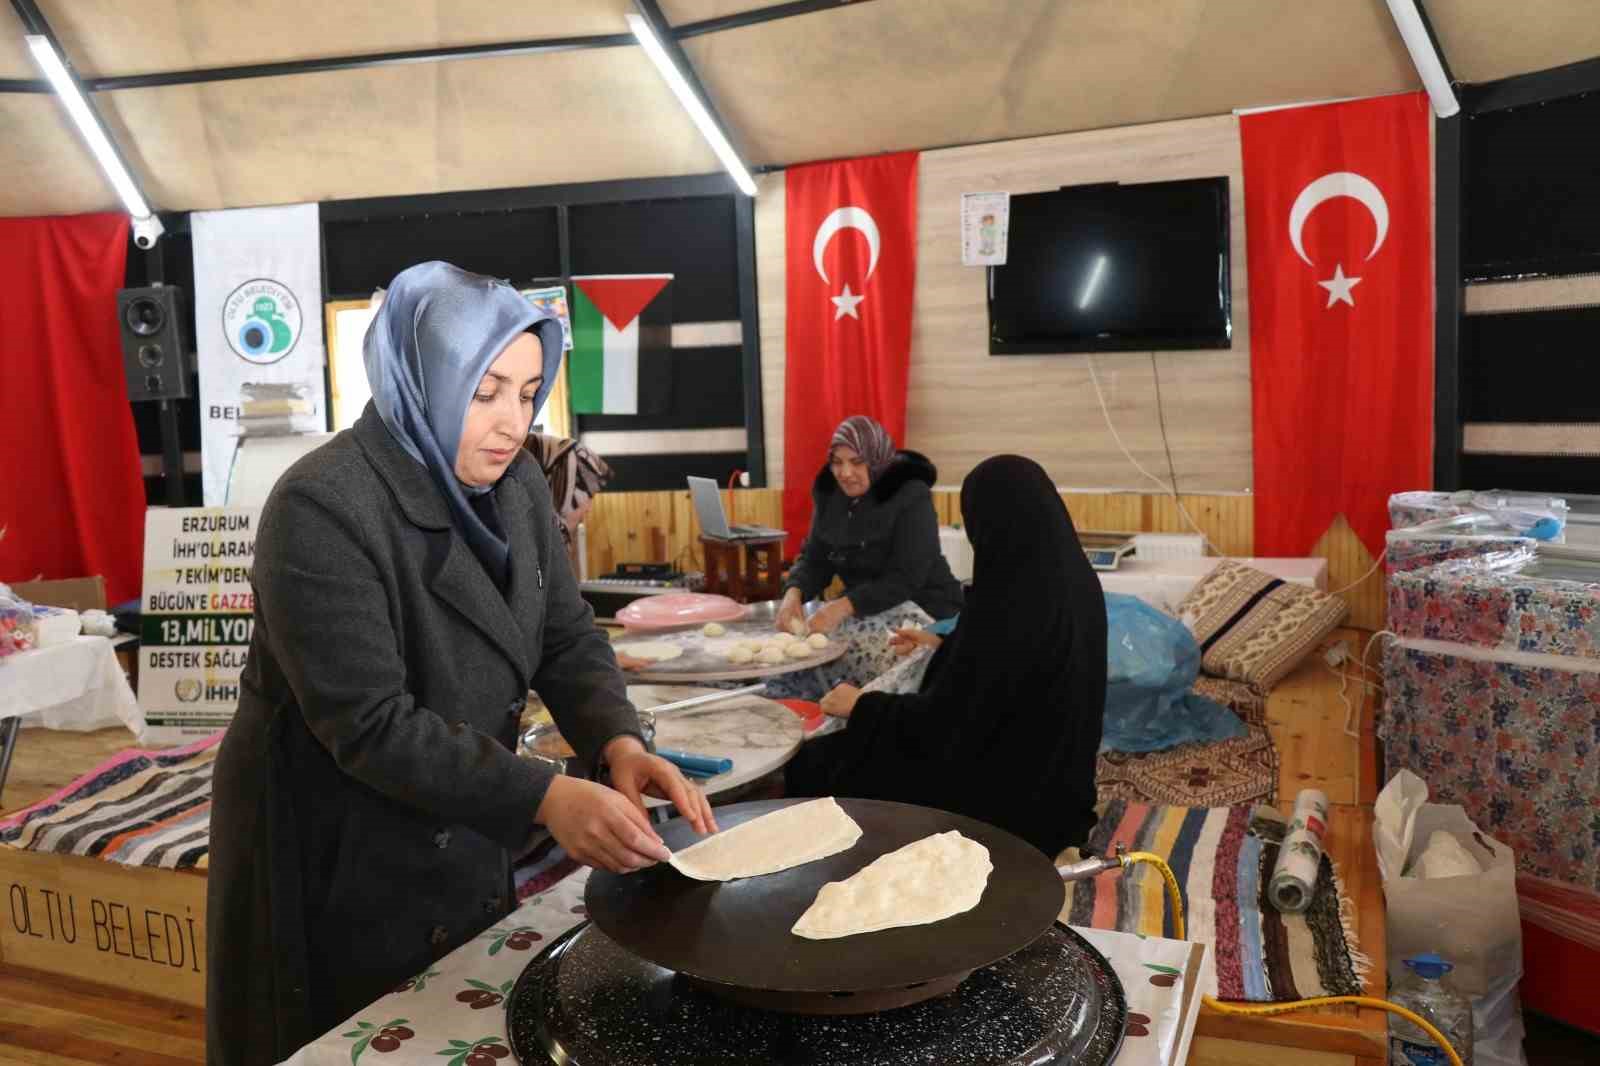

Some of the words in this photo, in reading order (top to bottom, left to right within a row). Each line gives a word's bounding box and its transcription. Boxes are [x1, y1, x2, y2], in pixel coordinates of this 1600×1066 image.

[182, 515, 249, 532] ERZURUM
[175, 569, 183, 585] 7
[150, 593, 207, 611] BÜGÜN'E
[150, 652, 200, 668] DESTEK
[9, 883, 77, 945] OLTU
[91, 899, 201, 973] BELEDİ
